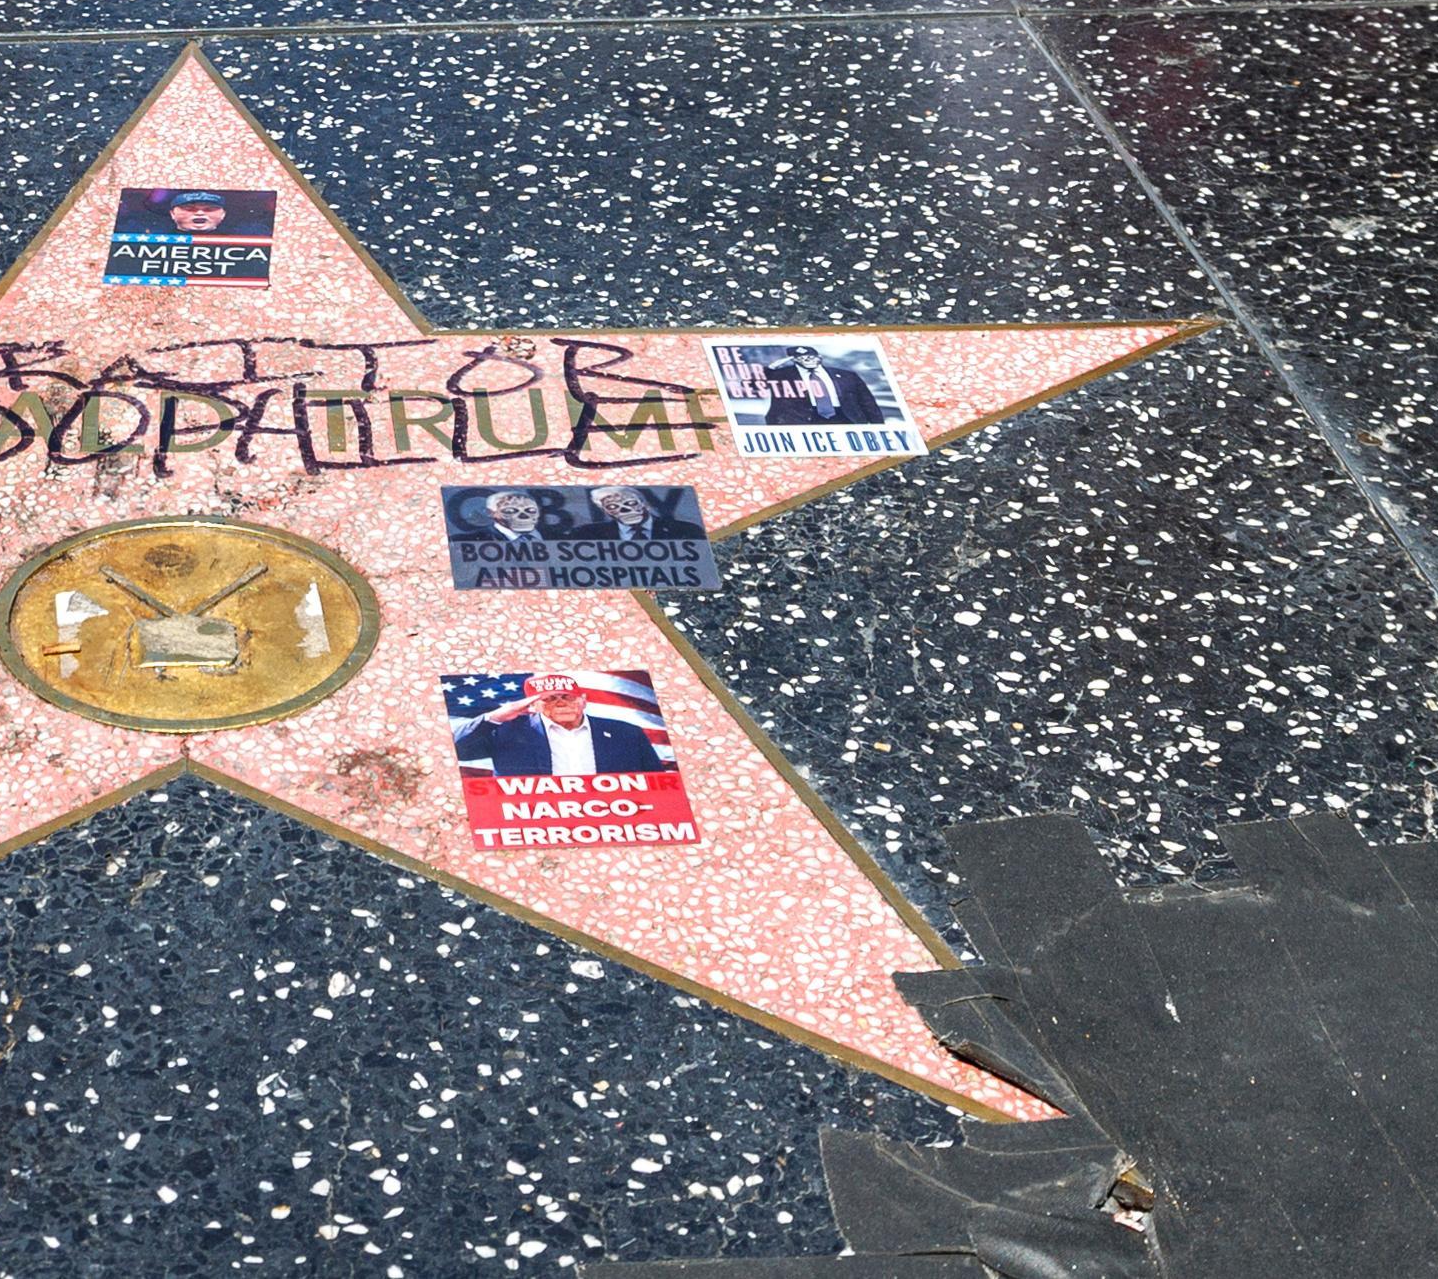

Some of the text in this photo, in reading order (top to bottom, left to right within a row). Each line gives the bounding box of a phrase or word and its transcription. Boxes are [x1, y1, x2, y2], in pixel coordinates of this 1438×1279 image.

[113, 245, 268, 261] AMERICA
[141, 261, 235, 275] FIRST
[715, 347, 744, 364] BE
[721, 363, 767, 380] OUR
[726, 380, 825, 399] GESTAPO
[744, 430, 912, 453] JOIN ICE OBEY
[462, 541, 700, 563] BOMB SCHOOLS
[475, 566, 701, 588] AND HOSPITALS
[496, 774, 648, 795] WAR ON
[501, 799, 654, 821] NARCO-
[474, 822, 696, 846] TERRORISM
